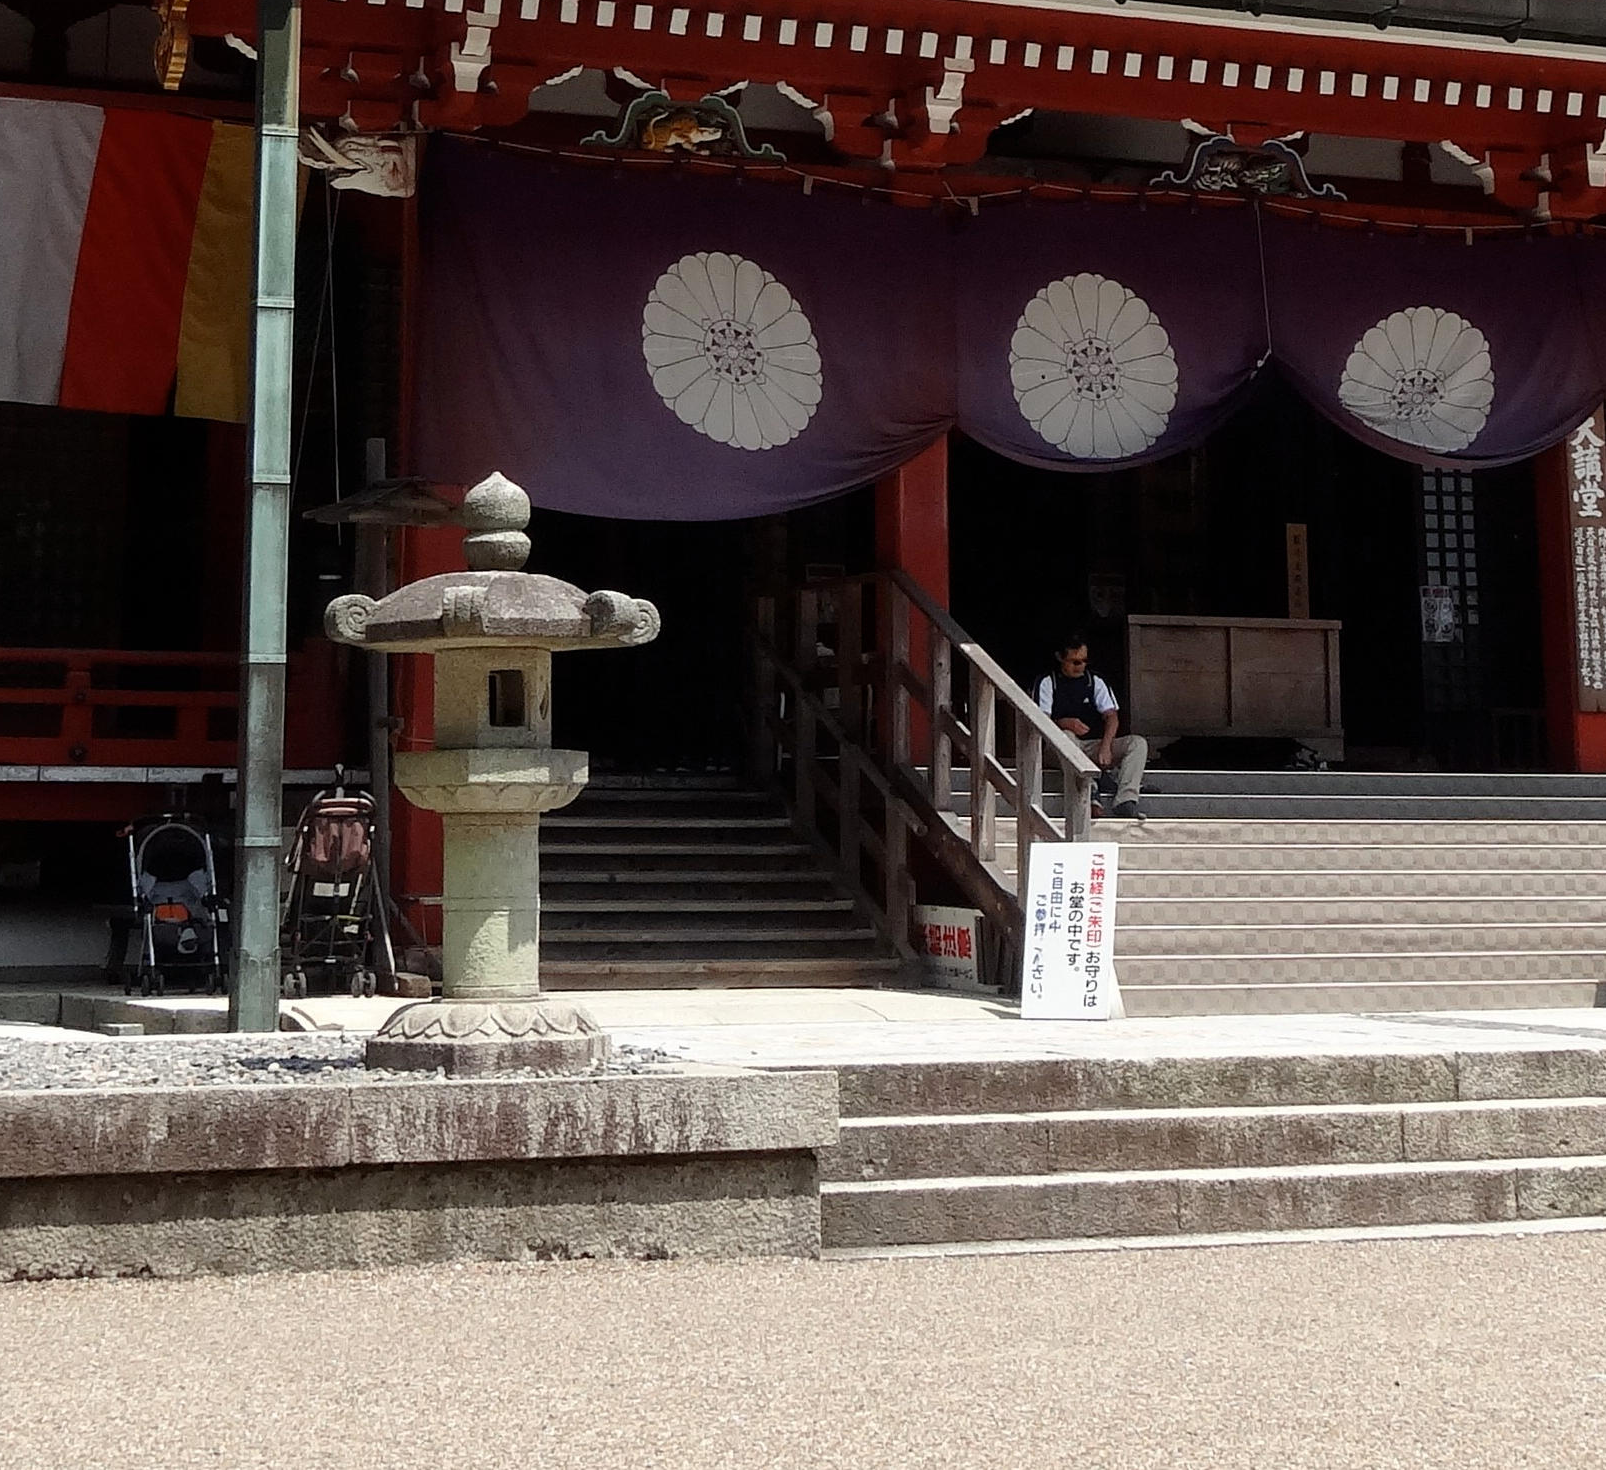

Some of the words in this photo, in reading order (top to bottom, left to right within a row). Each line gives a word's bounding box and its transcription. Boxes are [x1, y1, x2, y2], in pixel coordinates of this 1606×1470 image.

[1569, 416, 1606, 518] 大講堂
[917, 923, 972, 959] 結注意
[1066, 881, 1085, 972] お堂の中です。
